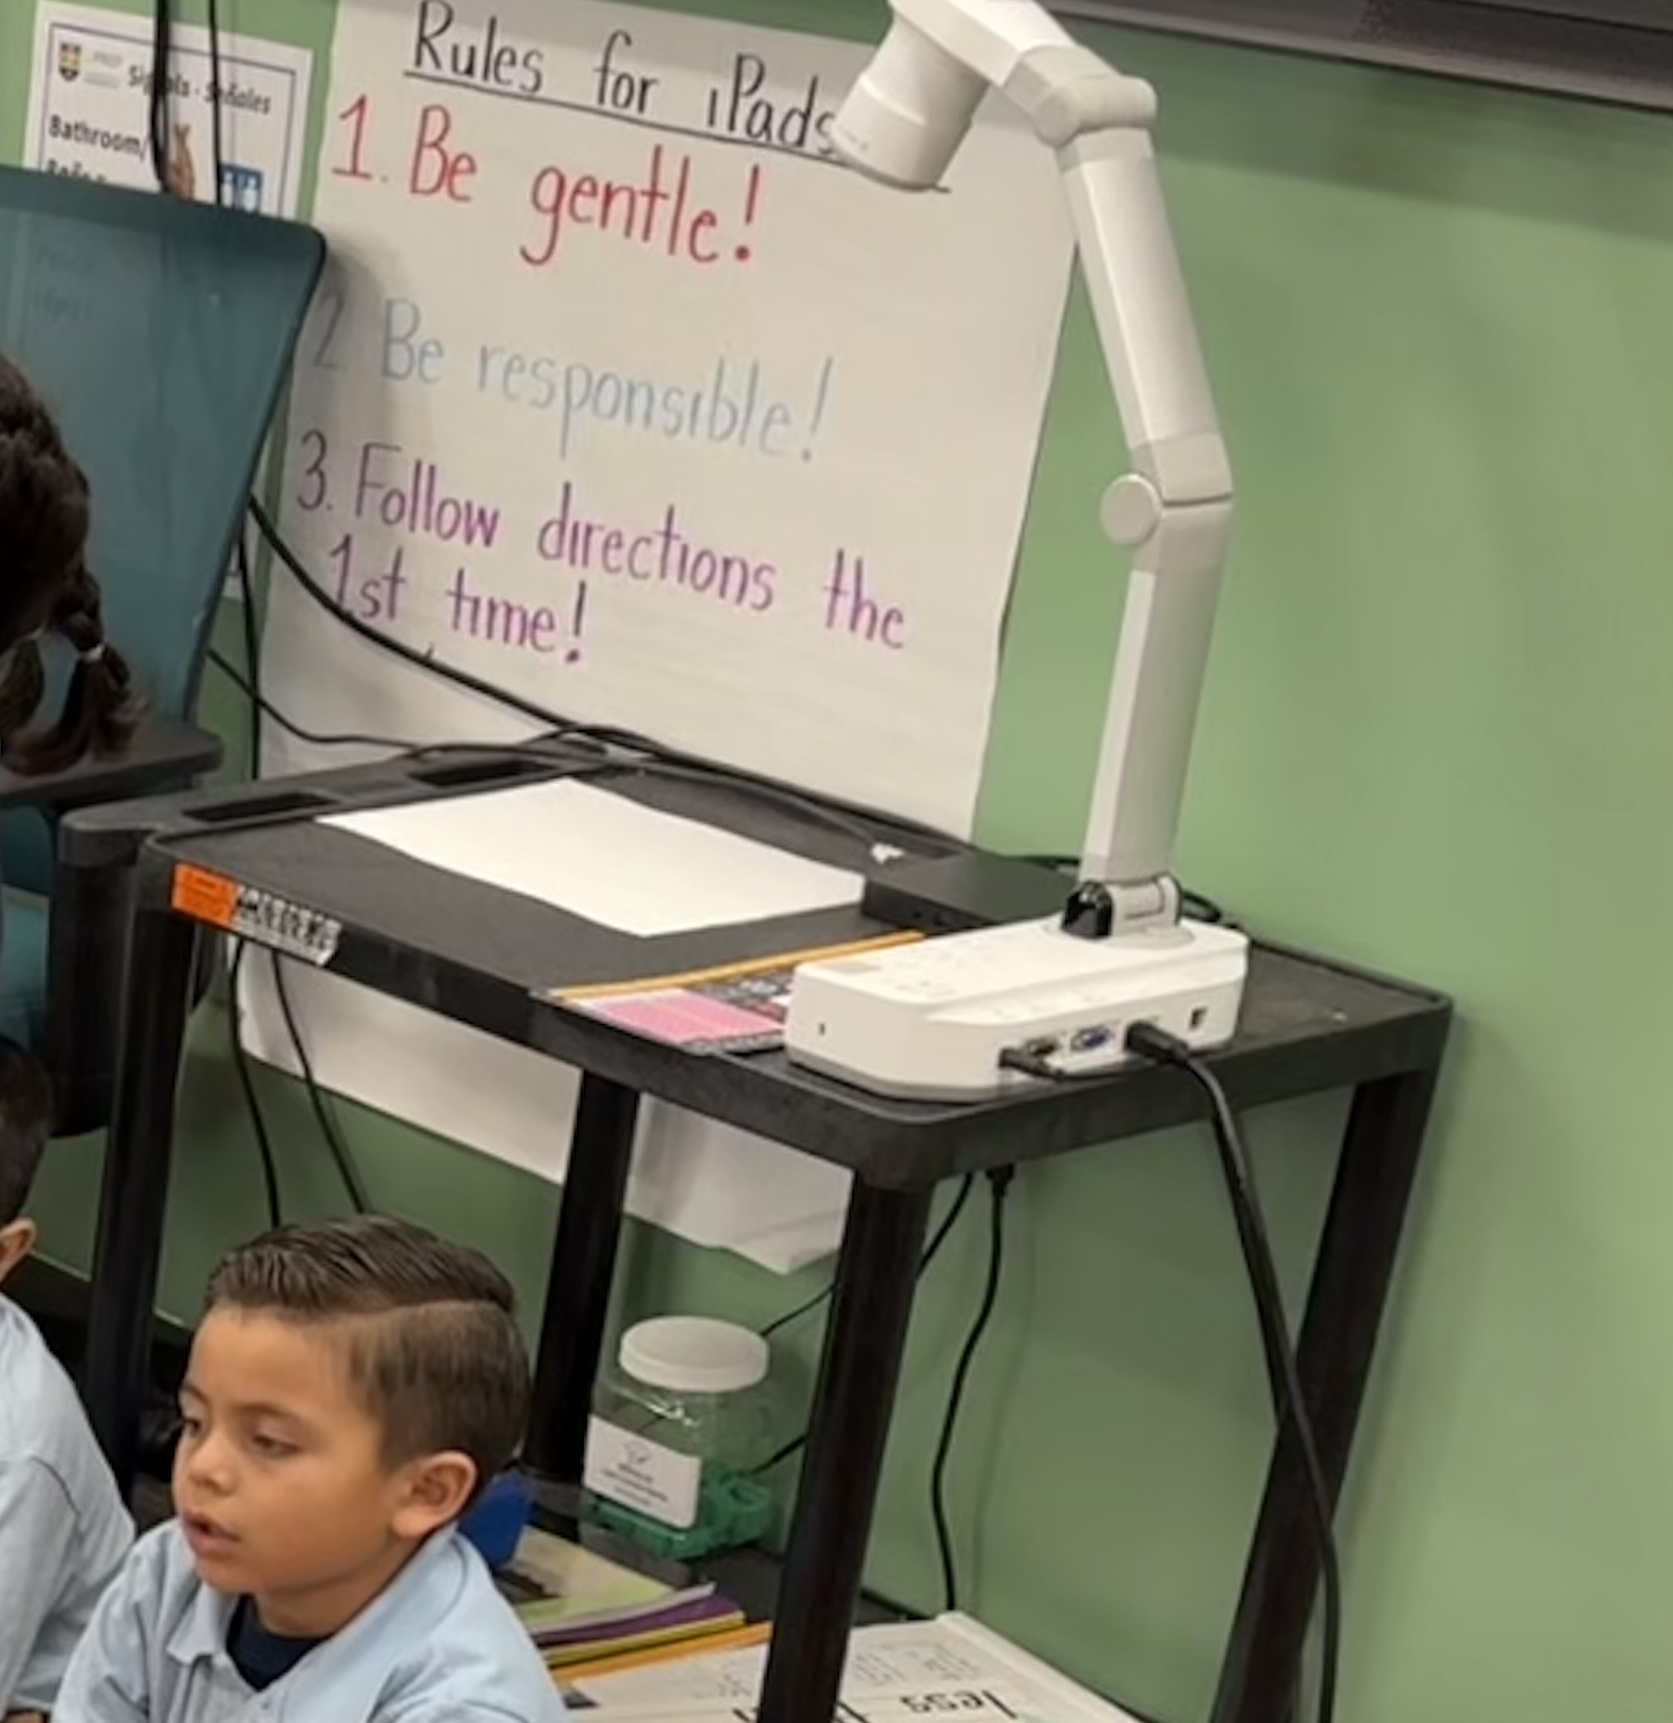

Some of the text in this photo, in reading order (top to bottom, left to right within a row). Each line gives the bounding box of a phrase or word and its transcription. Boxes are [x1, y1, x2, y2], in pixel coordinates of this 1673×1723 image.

[413, 0, 837, 156] Rules for iPads
[331, 94, 761, 266] 1. Be gentle!
[381, 297, 446, 384] Be
[478, 354, 835, 462] responsible!
[296, 428, 906, 650] 3. Follow directions the
[329, 533, 587, 665] 1st time!
